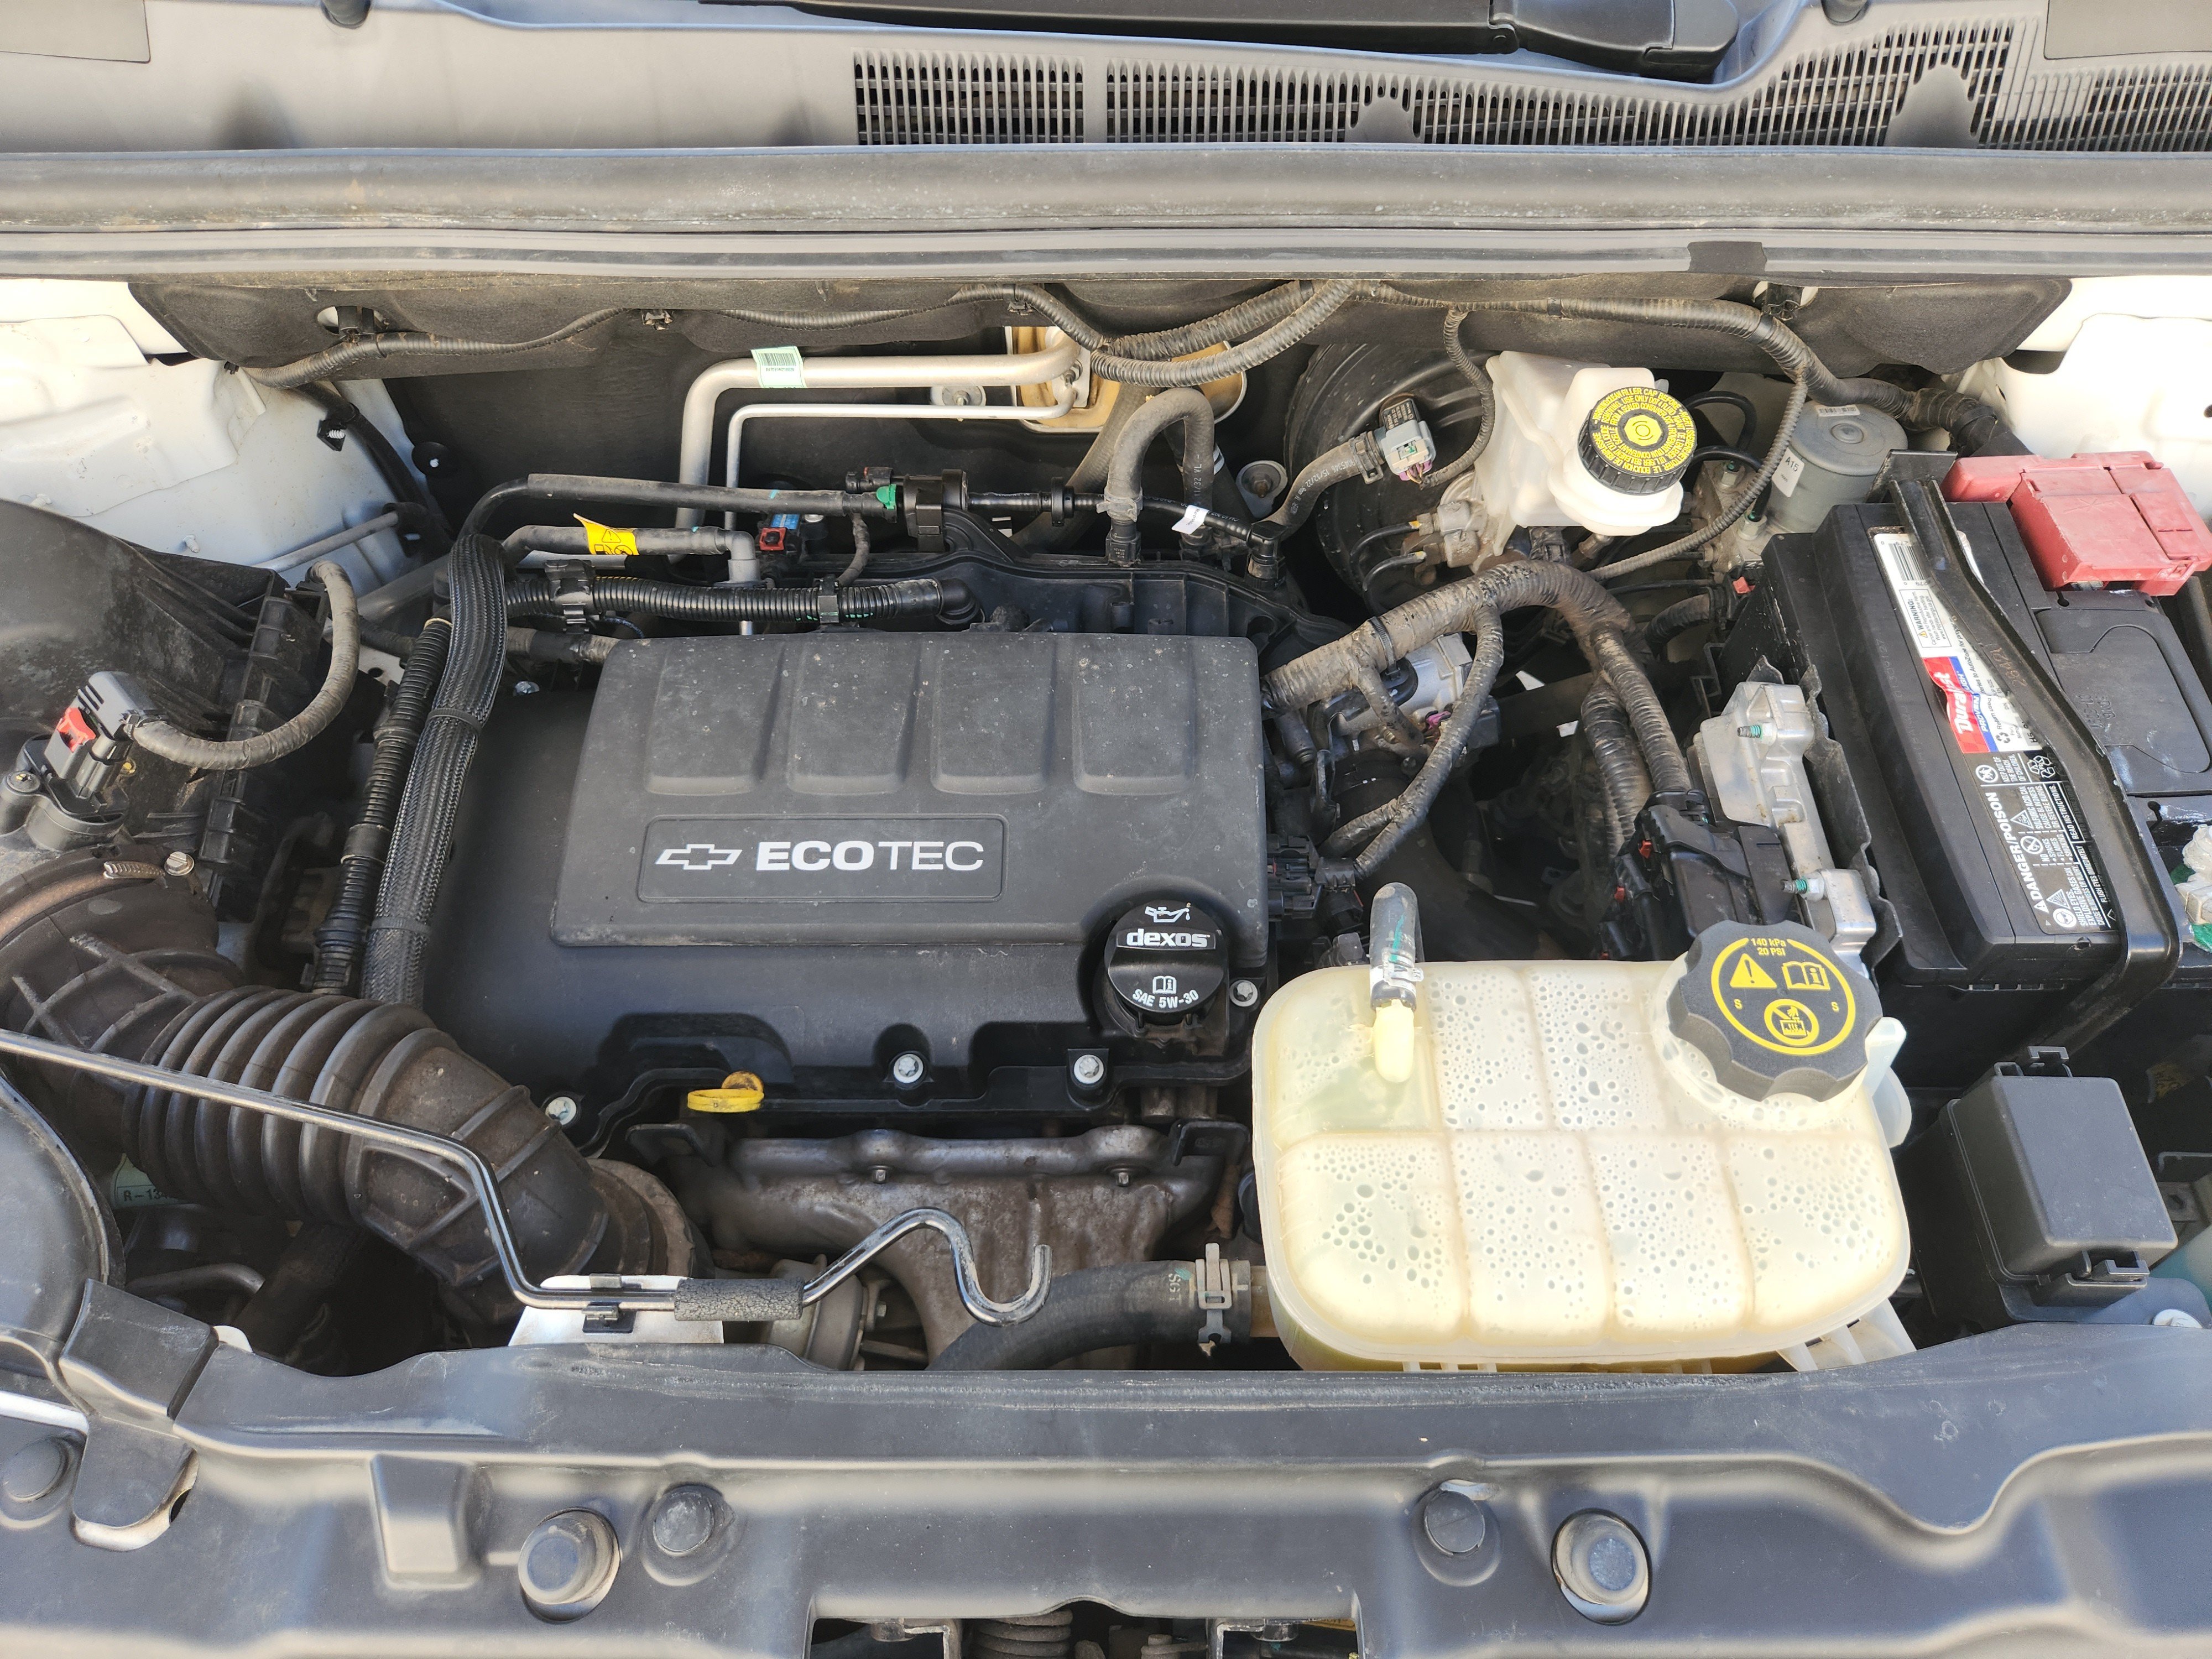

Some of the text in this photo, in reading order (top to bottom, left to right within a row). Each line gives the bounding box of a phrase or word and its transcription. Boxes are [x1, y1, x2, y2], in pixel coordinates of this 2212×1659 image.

[1619, 387, 1642, 397] FILLER
[1643, 388, 1658, 398] CAP
[1657, 392, 1682, 410] BEFORE
[1600, 399, 1624, 424] REMOVING.
[1620, 395, 1635, 405] USE
[1634, 394, 1648, 403] ONLY
[1648, 395, 1661, 406] DOT
[1660, 401, 1677, 416] FLUID
[1609, 411, 1622, 426] FROM
[1619, 402, 1640, 413] SEALED
[1662, 414, 1674, 425] DOT
[1671, 413, 1686, 430] AVANT
[1605, 441, 1618, 451] DU
[1660, 427, 1677, 455] PROVENANT
[1612, 447, 1642, 466] SEULEMENT
[1617, 442, 1652, 459] CONTENANT
[1611, 456, 1624, 467] DE
[1621, 461, 1651, 474] BOUCHON
[1651, 465, 1662, 473] LE
[1785, 456, 1799, 472] A15
[1193, 463, 1202, 496] 11/32 VL
[1305, 468, 1330, 488] 15/12/22
[1906, 598, 1924, 630] WARNING:
[1985, 697, 1994, 711] used
[1972, 695, 1988, 732] PROVEN
[1989, 712, 2004, 729] Return
[2003, 760, 2014, 773] REACH
[2000, 772, 2010, 782] KEEP
[2022, 795, 2034, 806] ACID
[2035, 784, 2048, 801] BURNS.
[2027, 786, 2052, 828] CAUSE BLINDNESS
[2043, 802, 2057, 820] SEVERE
[2048, 784, 2079, 839] READ INSTRUCTIONS.
[2027, 807, 2044, 828] SULFURIC
[1984, 791, 2043, 899] DANGER/POISON
[2042, 839, 2057, 857] SPARKS
[2050, 838, 2064, 857] FLAMES
[2056, 834, 2073, 856] SMOKING
[756, 840, 983, 872] ECOTEC
[2072, 865, 2085, 880] INJURY.
[2075, 845, 2108, 902] FLUSH EYES IMMEDIATELY
[2068, 877, 2083, 894] GASES
[2065, 889, 2088, 926] SHIELD EYES.
[2083, 888, 2099, 910] BLINDNESS
[2077, 896, 2097, 925] EXPLOSIVE
[2093, 911, 2105, 925] CAUSE
[1126, 928, 1208, 947] dexos
[1750, 937, 1786, 947] 140 kPa
[1757, 947, 1786, 957] 20 PSI
[1132, 988, 1199, 1009] SAE 5W-30
[1734, 998, 1742, 1009] S
[1830, 1001, 1839, 1012] S
